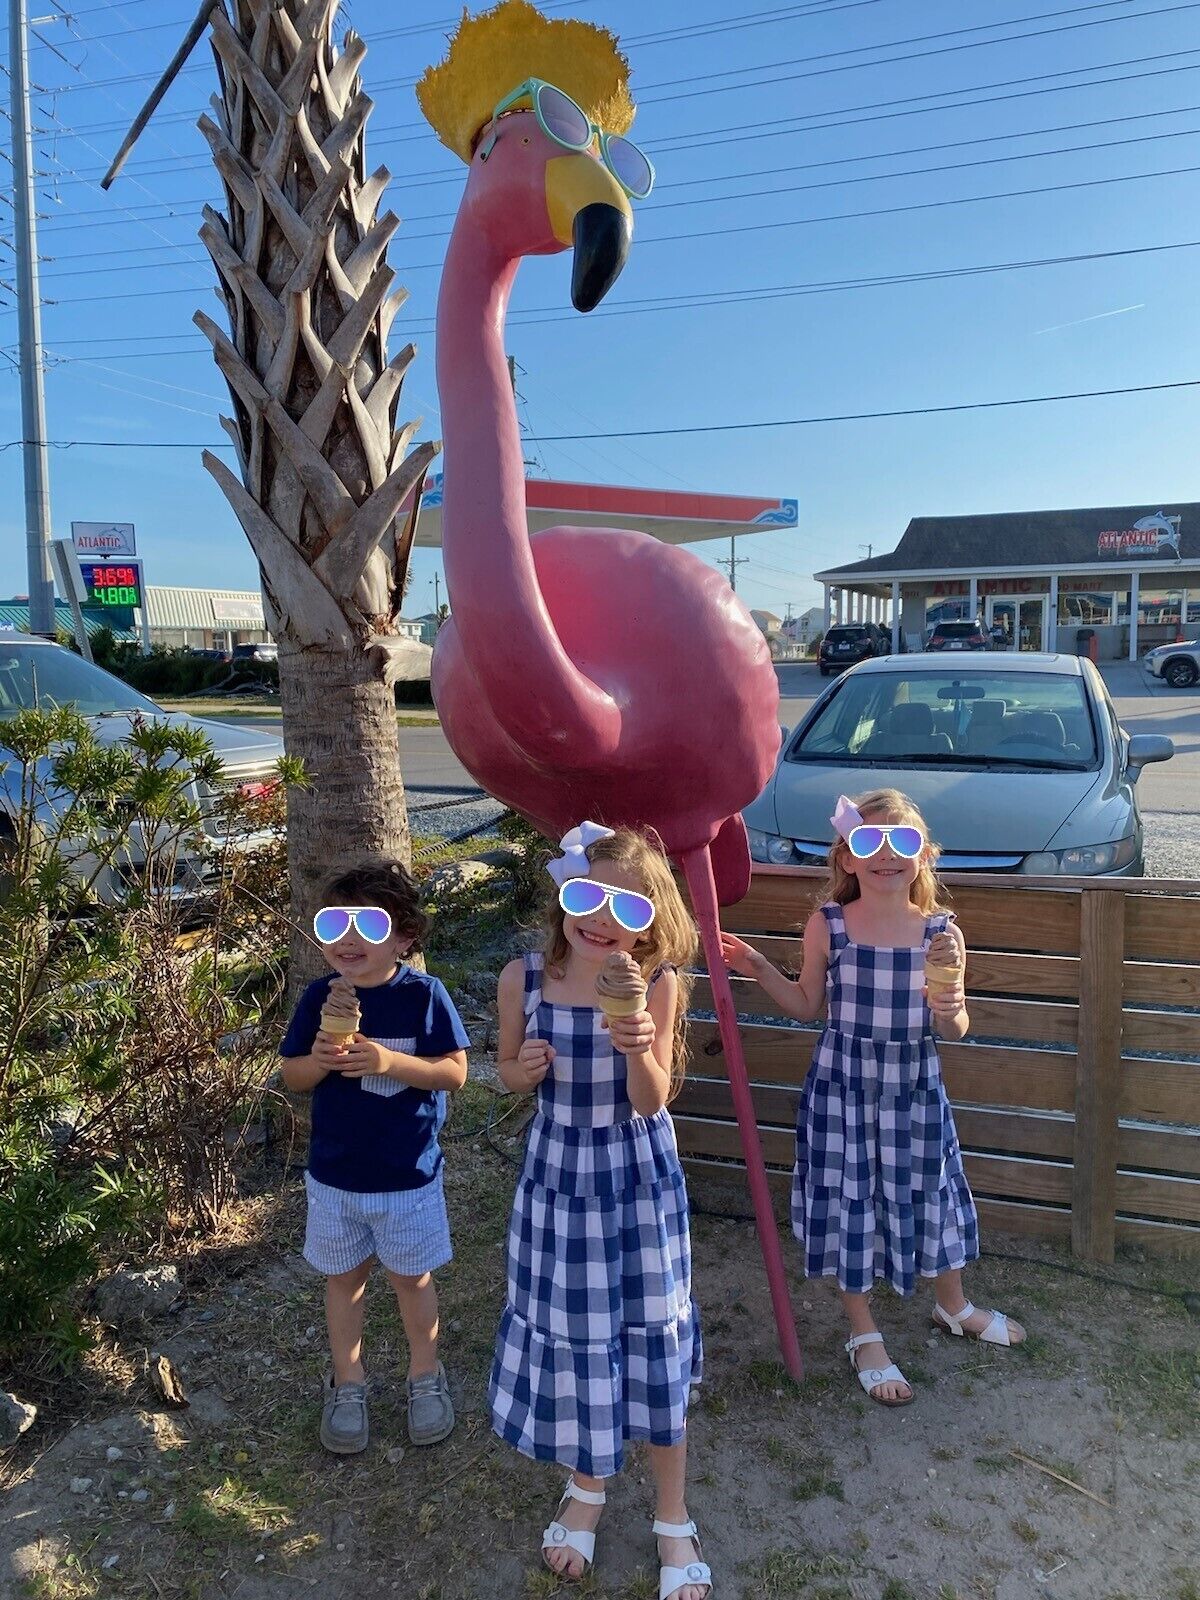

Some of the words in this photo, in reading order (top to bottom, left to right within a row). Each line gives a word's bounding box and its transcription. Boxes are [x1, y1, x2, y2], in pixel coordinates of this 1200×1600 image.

[78, 536, 121, 548] ATLANTIC
[1097, 529, 1157, 548] ATLANTIC
[933, 579, 1032, 597] ATLNTIC
